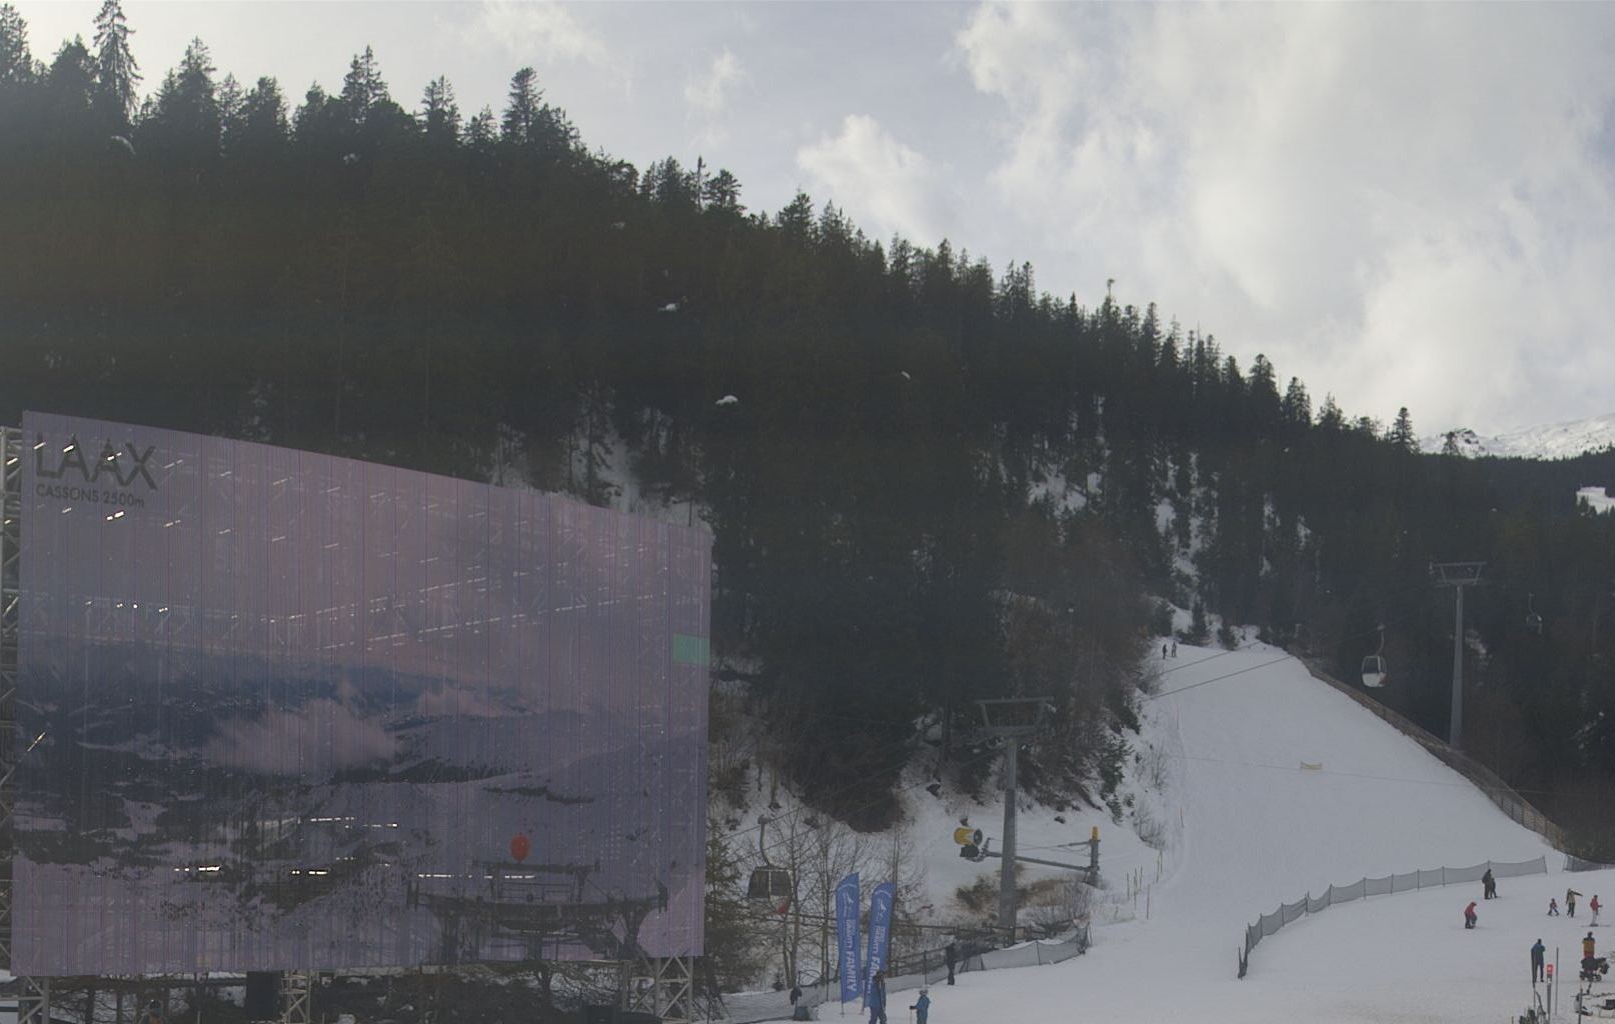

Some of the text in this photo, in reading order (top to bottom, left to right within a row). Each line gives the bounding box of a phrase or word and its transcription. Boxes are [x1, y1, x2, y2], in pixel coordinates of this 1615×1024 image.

[35, 432, 158, 490] LAAX
[36, 483, 145, 508] CASSONS 2500m
[846, 951, 857, 992] FAMILY
